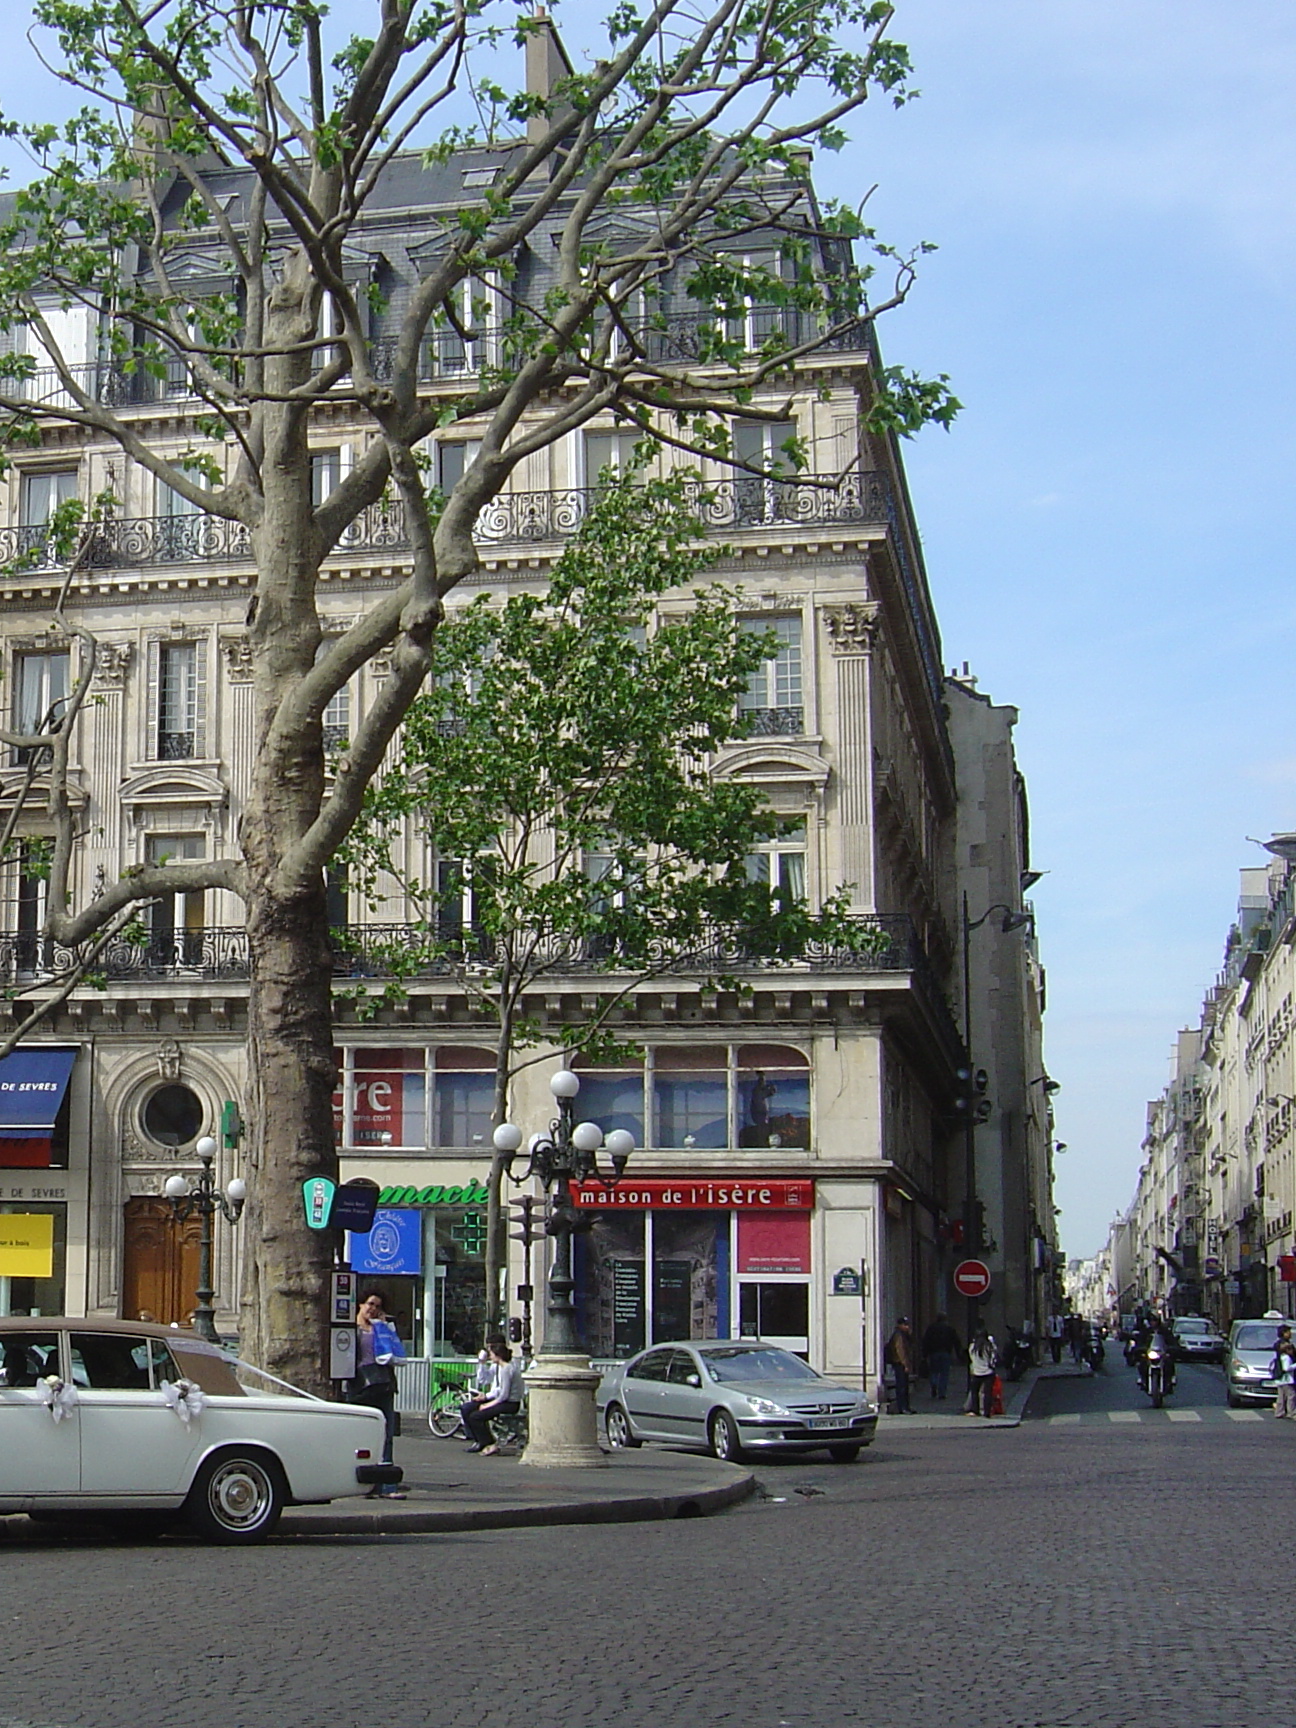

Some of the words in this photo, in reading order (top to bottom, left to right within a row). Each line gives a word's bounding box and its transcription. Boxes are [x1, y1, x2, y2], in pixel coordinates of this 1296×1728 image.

[1, 1083, 15, 1092] DE
[18, 1082, 58, 1092] SEVRES
[11, 1187, 23, 1198] DE
[31, 1187, 66, 1199] SEVRES
[377, 1177, 492, 1205] macie
[580, 1188, 651, 1204] maison
[661, 1188, 682, 1204] de
[691, 1184, 772, 1204] l'isère
[1208, 1219, 1217, 1254] HOTEL
